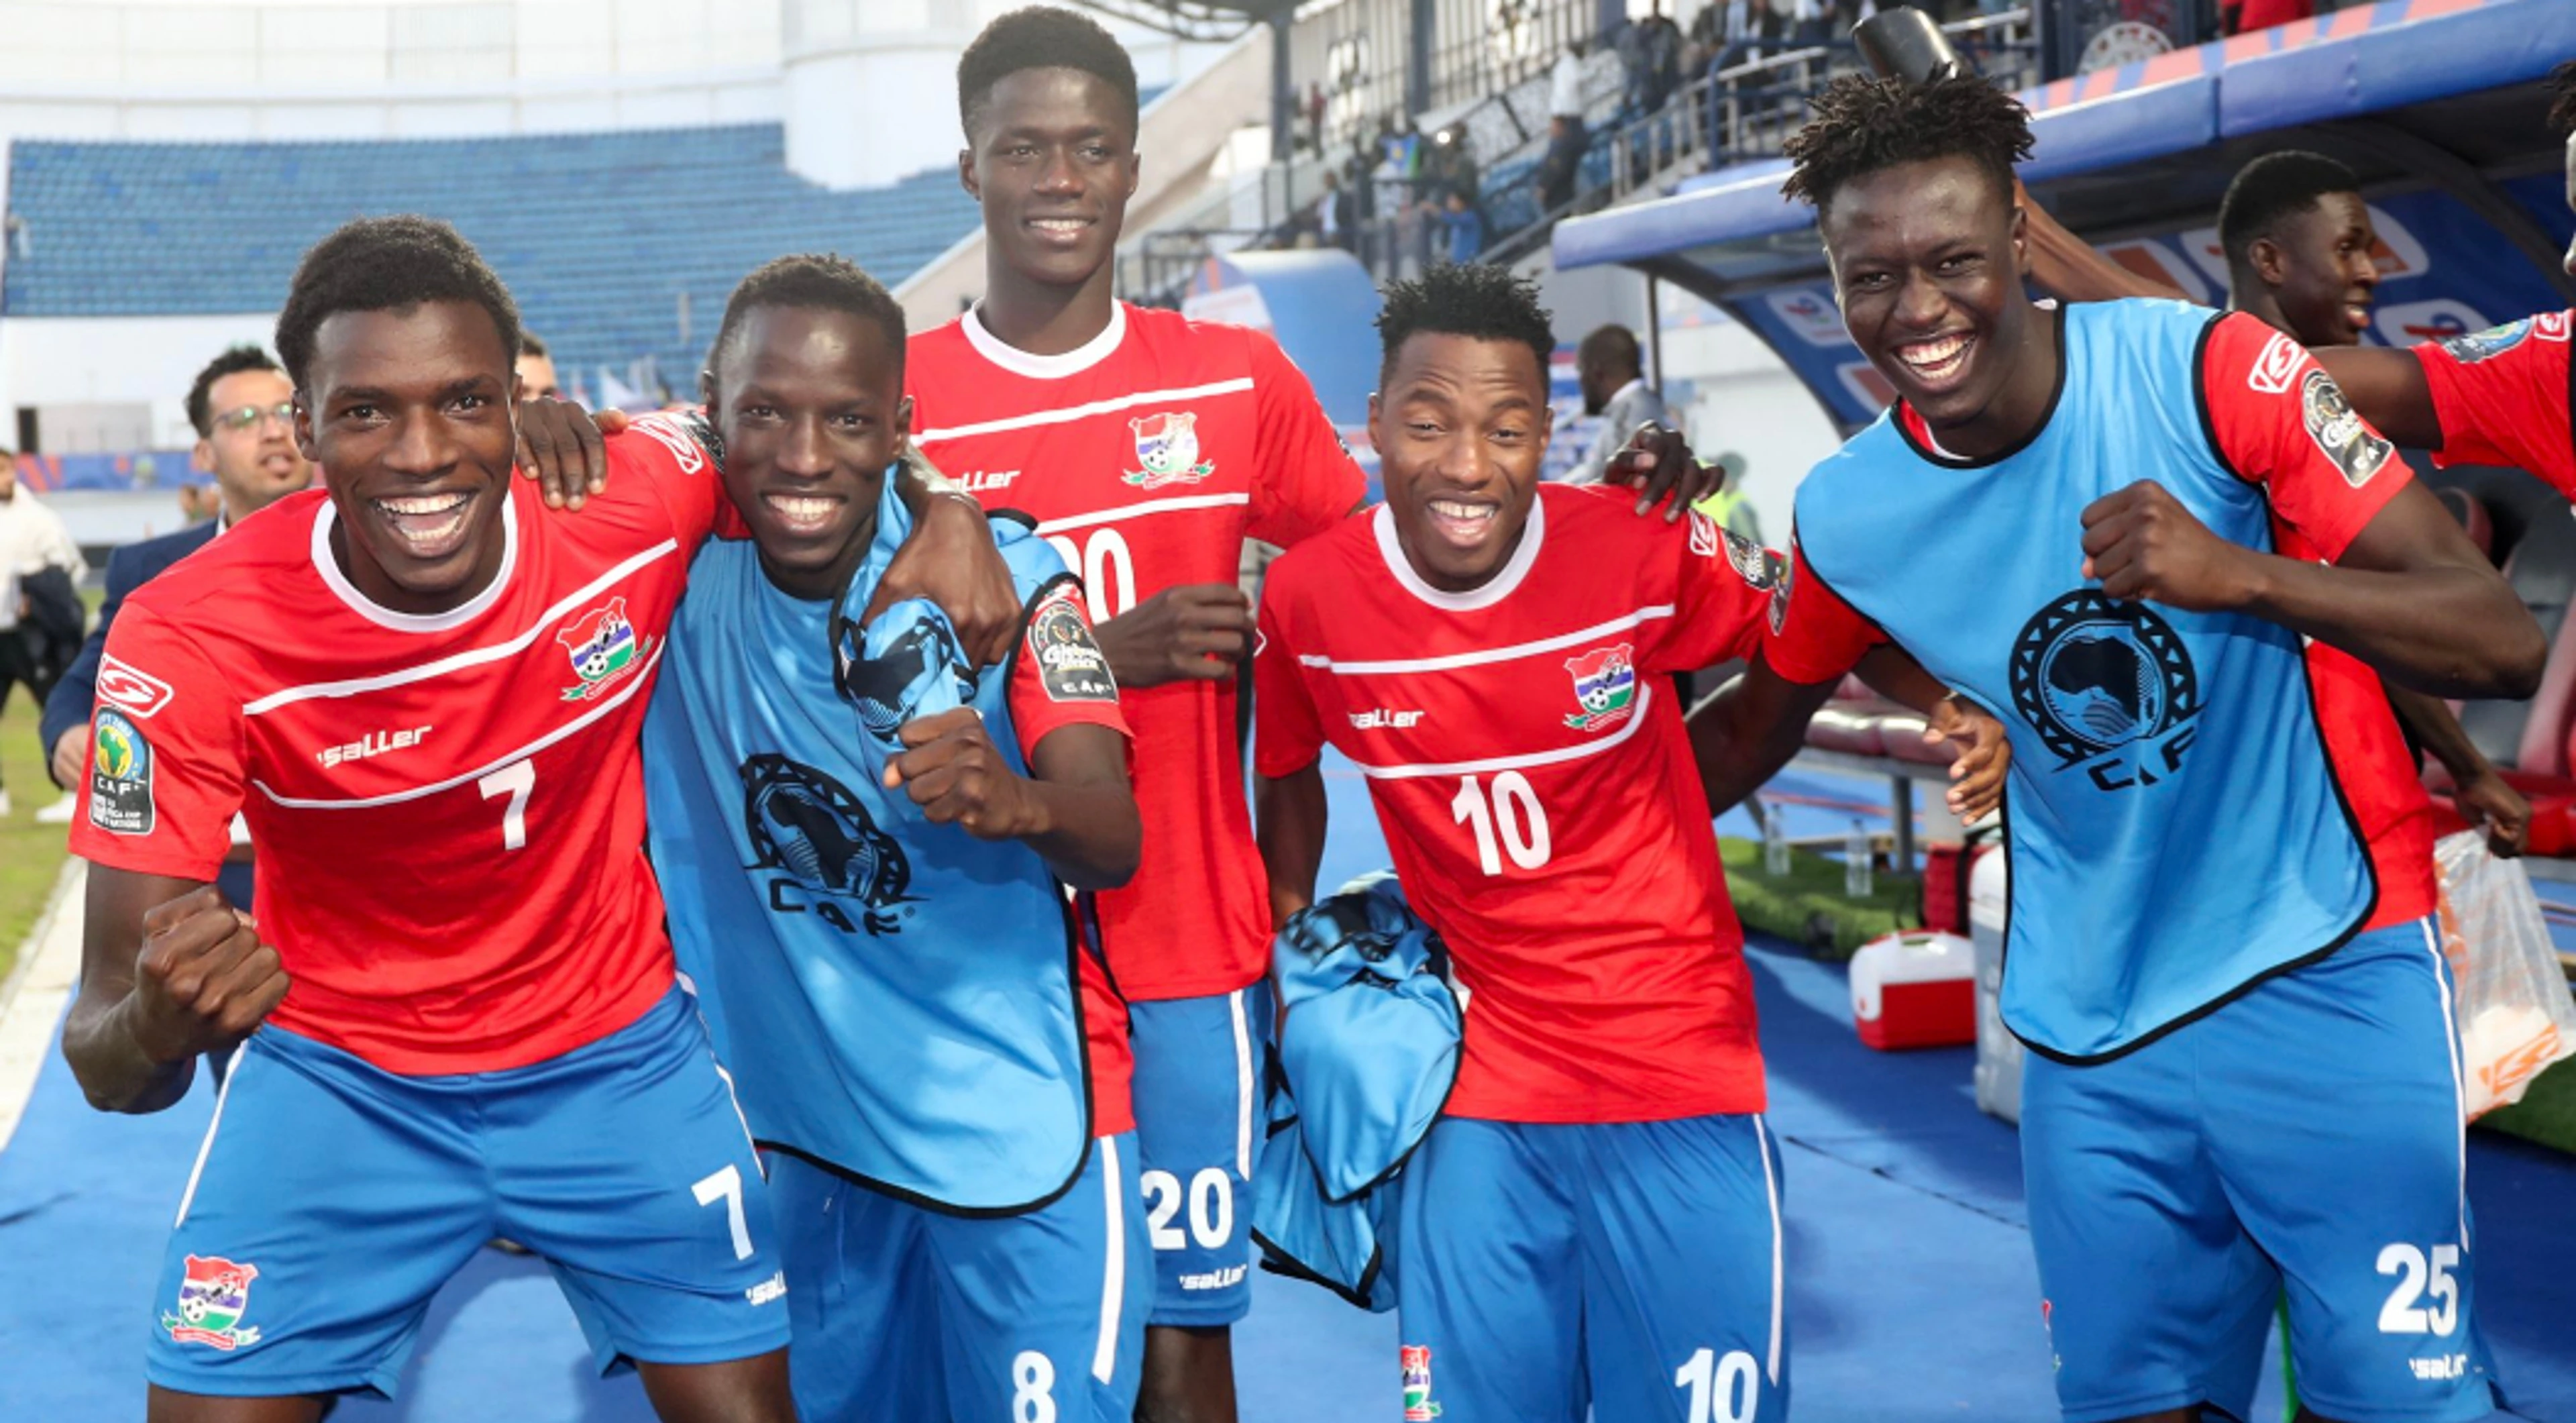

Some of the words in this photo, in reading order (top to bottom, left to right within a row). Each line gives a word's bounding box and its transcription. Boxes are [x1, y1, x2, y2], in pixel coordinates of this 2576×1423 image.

[478, 758, 535, 851] 7
[1451, 770, 1552, 877] 10
[690, 1163, 754, 1261] 7
[1140, 1166, 1234, 1250] 20
[2375, 1243, 2460, 1337] 25
[1012, 1350, 1057, 1423] 8
[1674, 1347, 1760, 1423] 10
